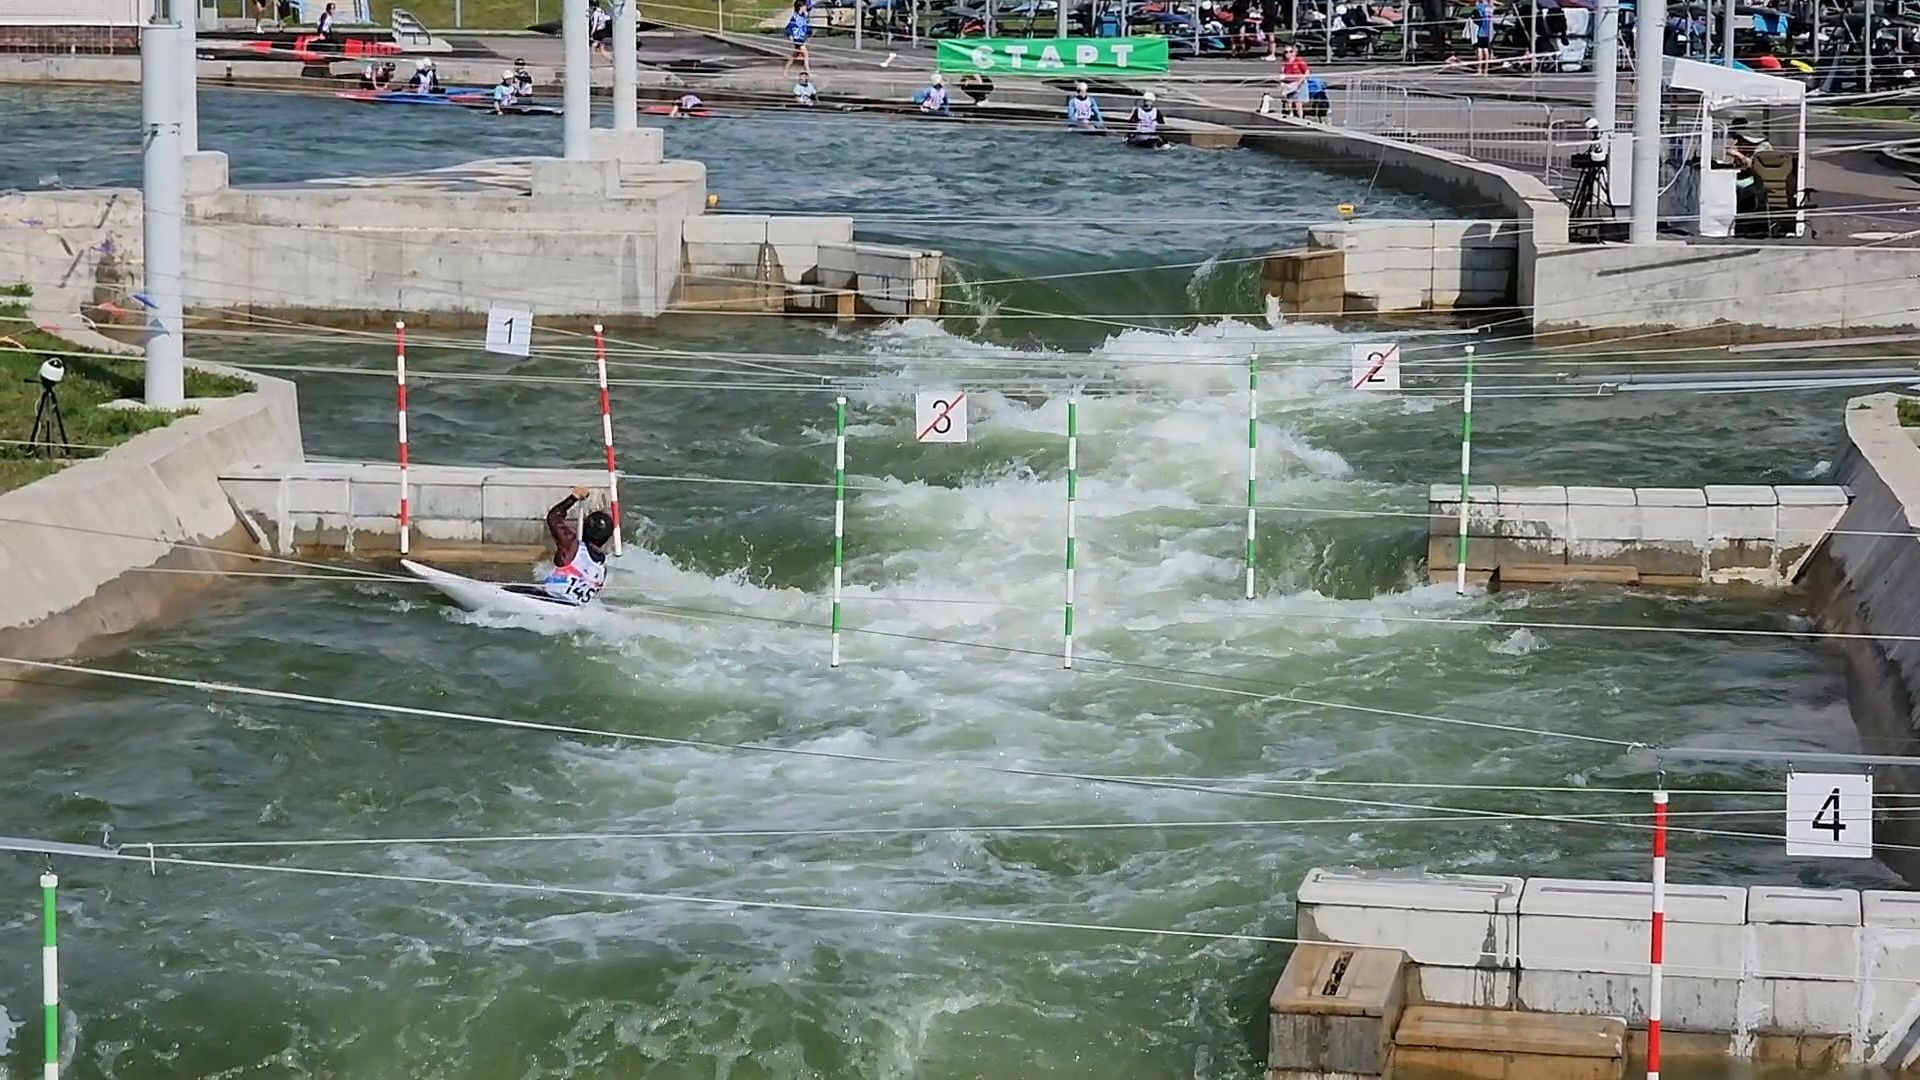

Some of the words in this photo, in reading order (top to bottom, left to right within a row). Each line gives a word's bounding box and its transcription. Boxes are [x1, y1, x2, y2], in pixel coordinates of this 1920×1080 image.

[971, 44, 1134, 69] СТАРТ
[504, 317, 514, 344] 1
[1367, 352, 1385, 382] 2
[932, 400, 951, 434] 3
[566, 577, 595, 603] 145
[1812, 787, 1846, 842] 4
